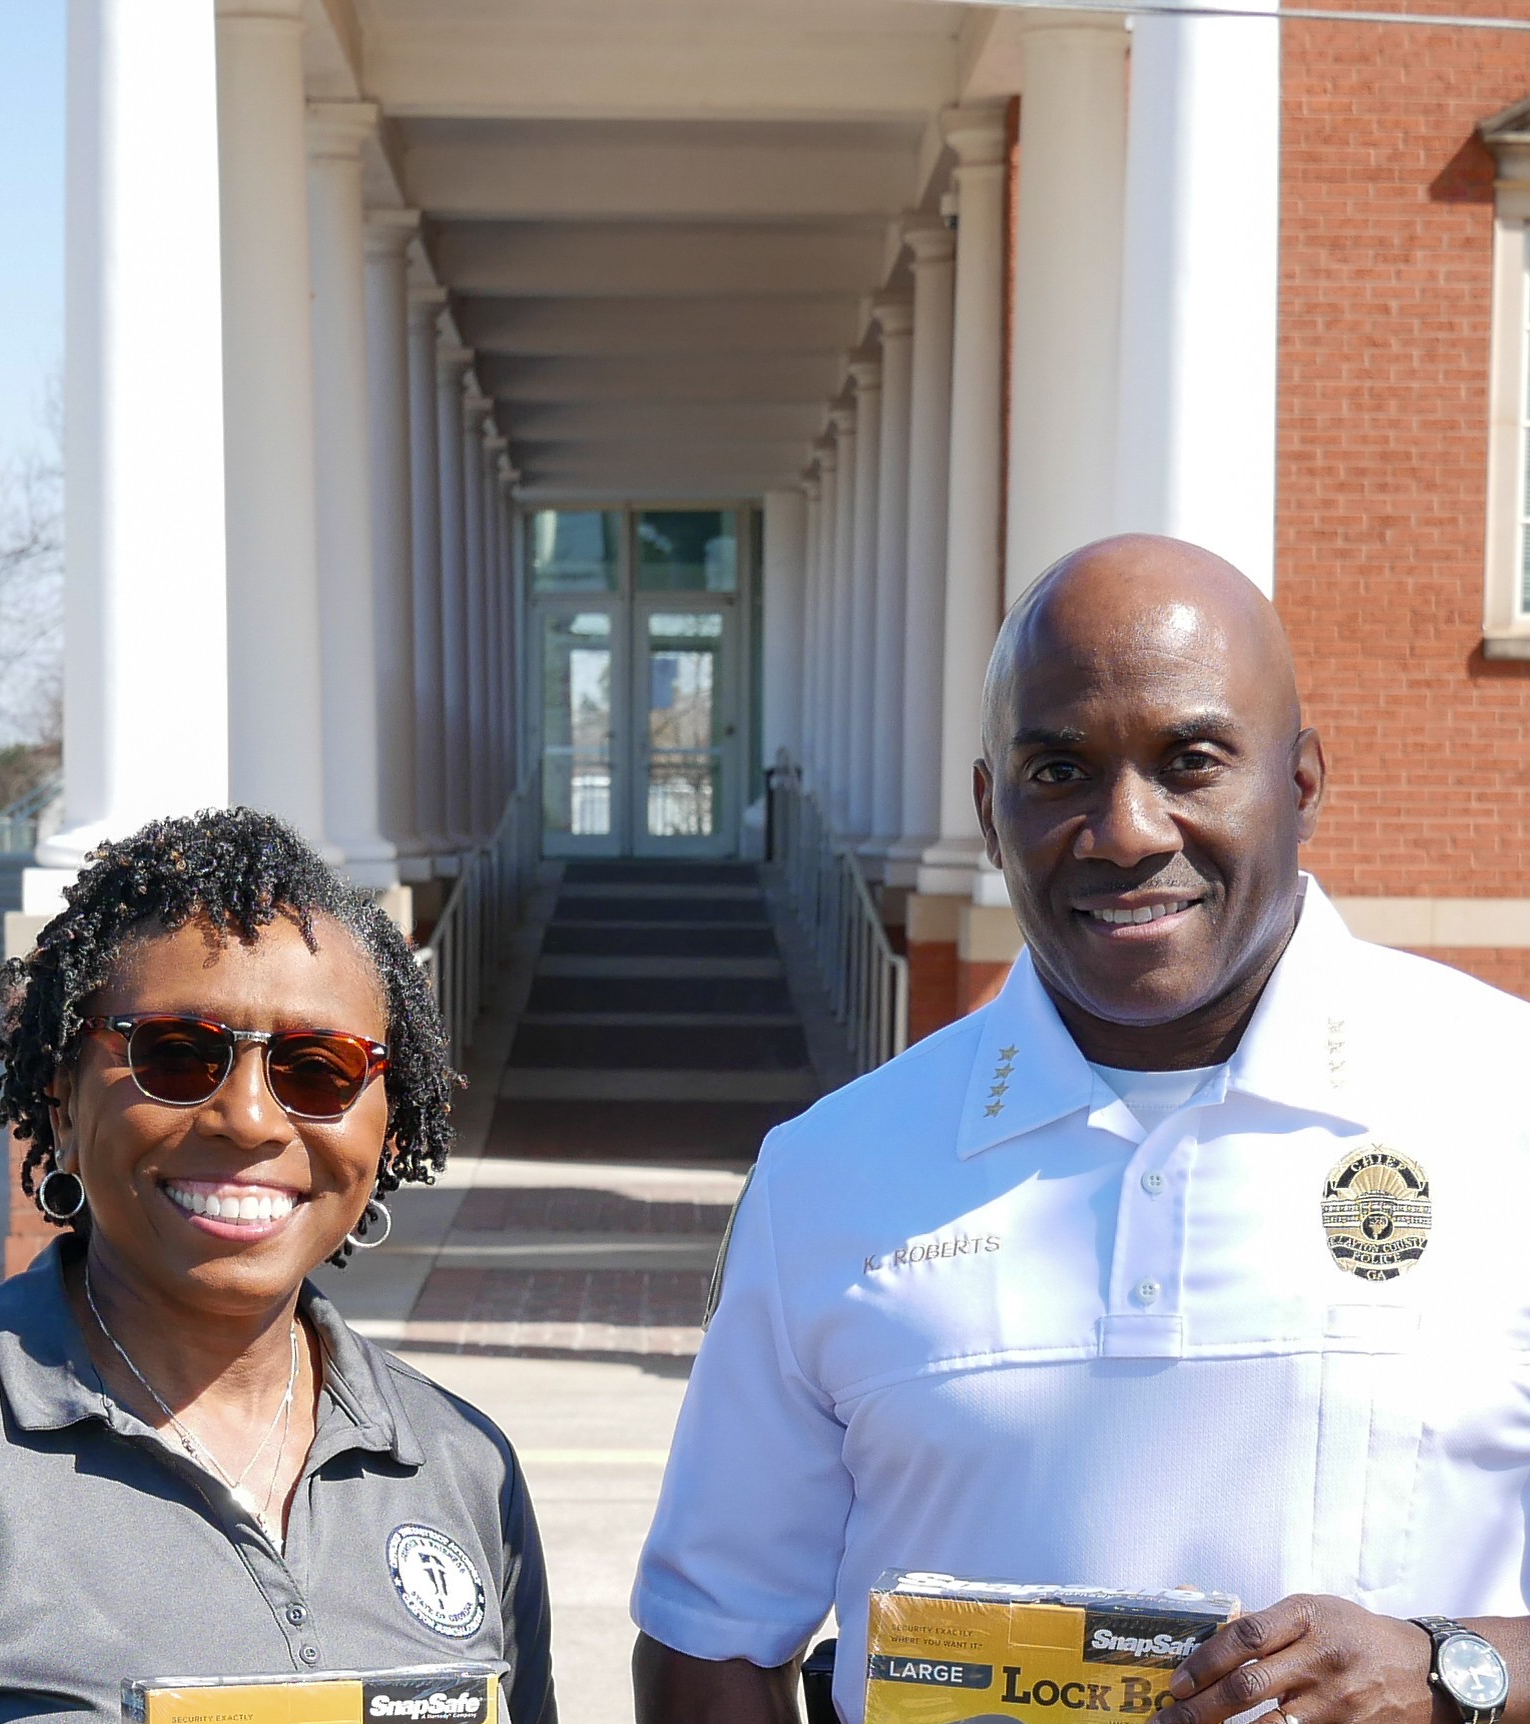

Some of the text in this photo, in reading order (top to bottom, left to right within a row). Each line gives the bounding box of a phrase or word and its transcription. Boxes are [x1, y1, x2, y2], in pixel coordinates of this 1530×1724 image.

[1351, 1154, 1407, 1172] CHIEF
[893, 1235, 1000, 1268] ROBERTS
[1353, 1251, 1401, 1265] POLICE
[1367, 1269, 1386, 1281] GA
[892, 1624, 973, 1637] SECURITY EXACTLY
[891, 1636, 968, 1649] WHERE YOU WANT
[1091, 1628, 1203, 1658] SnapSaf
[889, 1661, 963, 1683] LARGE
[1000, 1665, 1176, 1715] LOCK BO
[369, 1691, 481, 1721] SnapSafe
[171, 1713, 254, 1724] SECURITY EXACTLY
